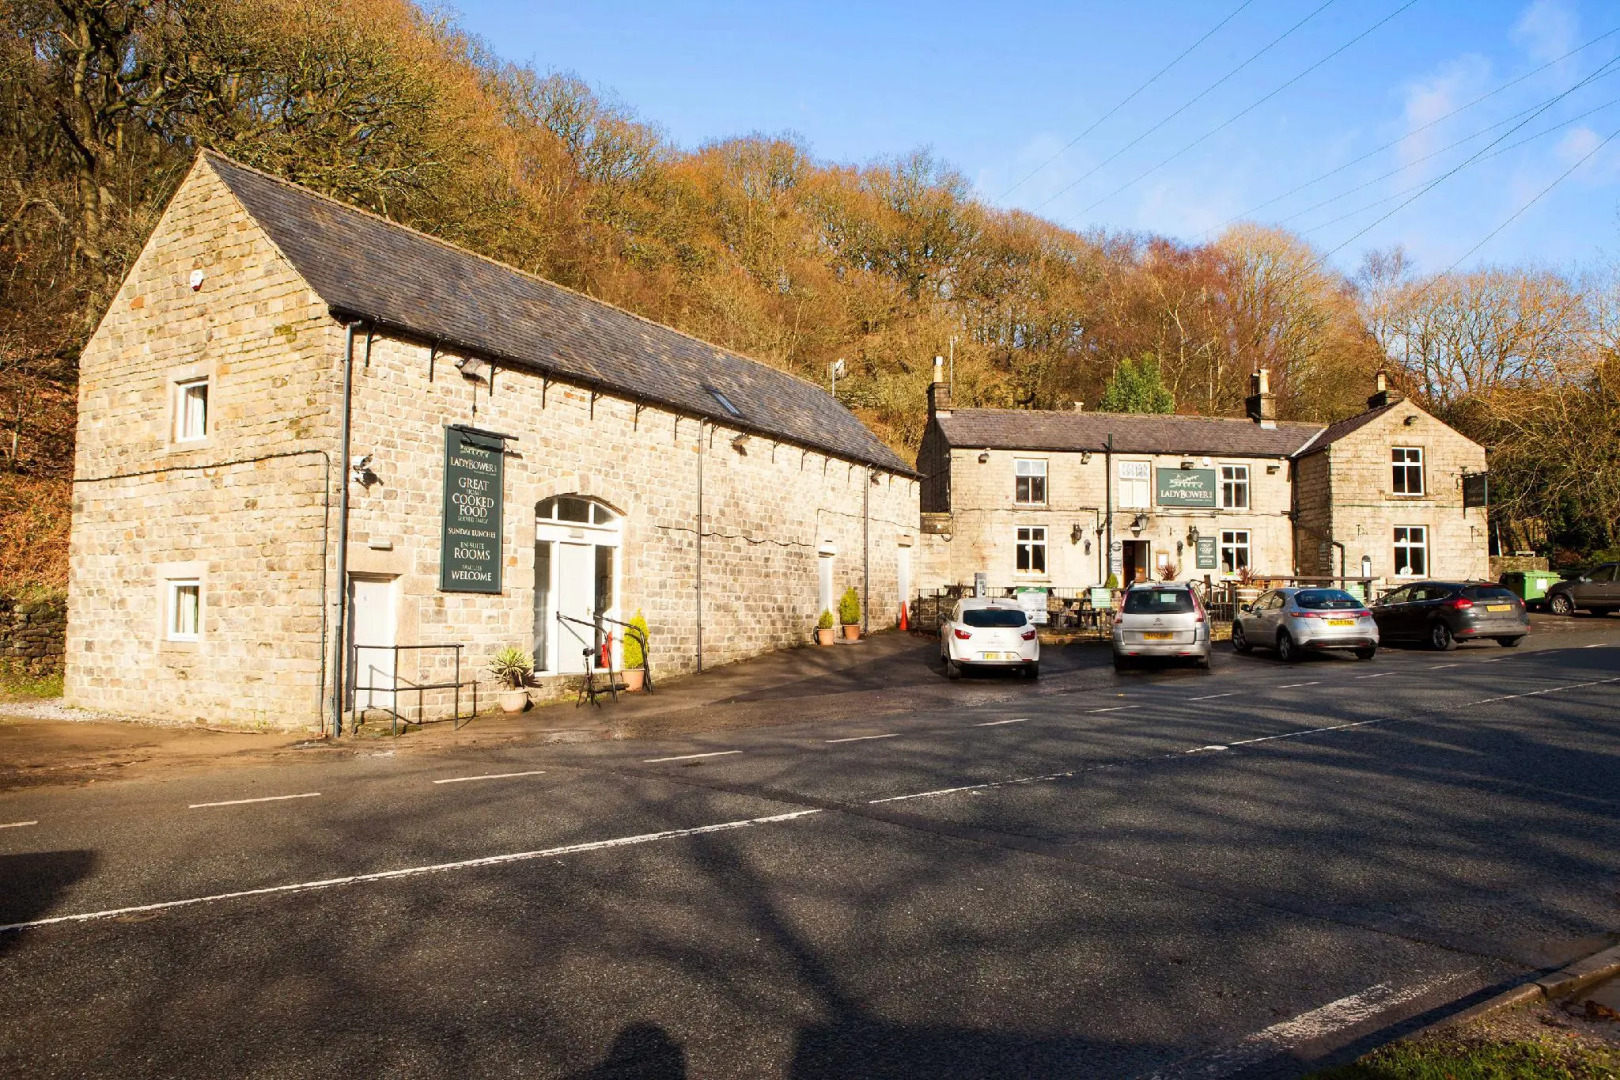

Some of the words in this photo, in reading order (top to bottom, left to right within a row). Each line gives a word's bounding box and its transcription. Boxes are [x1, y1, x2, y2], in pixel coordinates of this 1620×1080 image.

[450, 457, 494, 472] LADYBOWER
[458, 477, 490, 491] GREAT
[452, 493, 494, 508] COOKED
[1160, 490, 1209, 499] LADYBOWER
[460, 505, 488, 517] FOOD
[448, 528, 470, 536] SUNDAY
[454, 548, 490, 560] ROOMS
[451, 570, 491, 581] WELCOME
